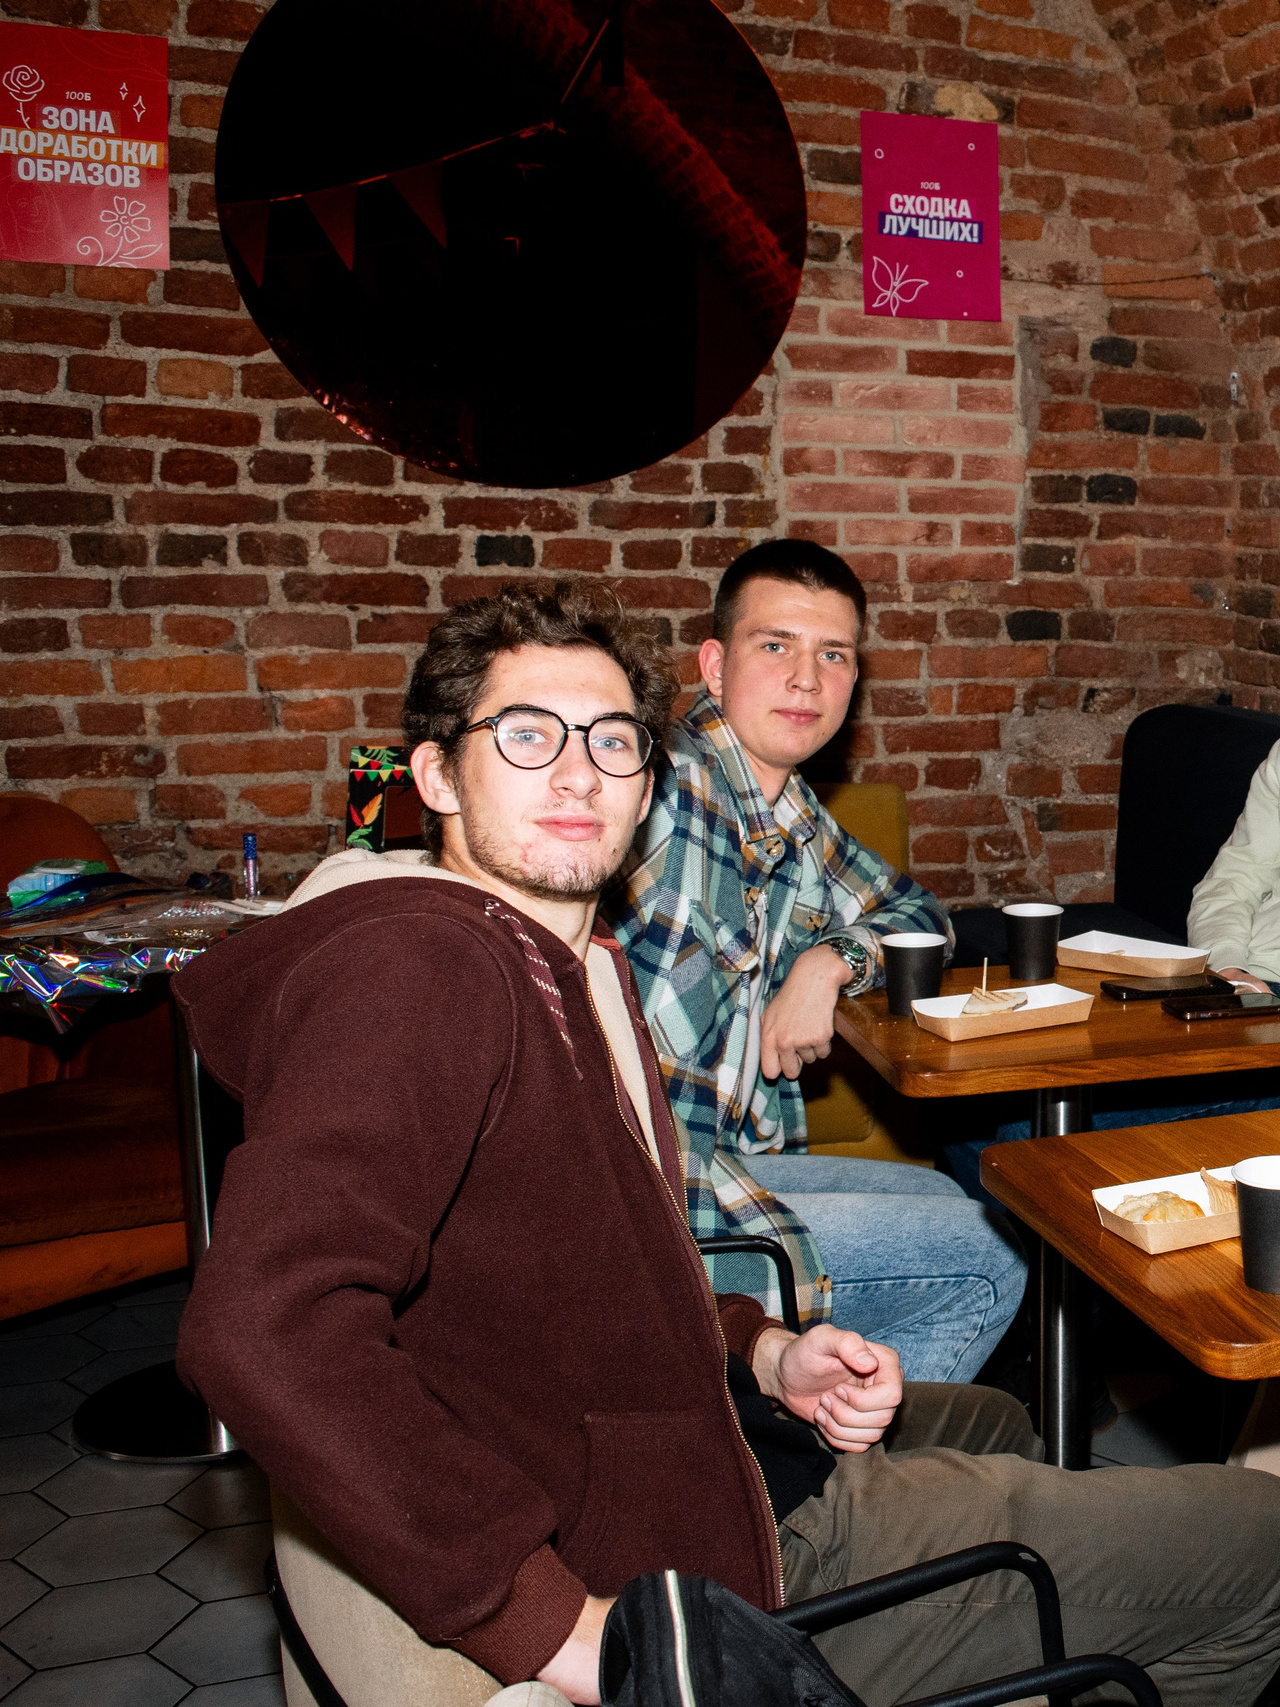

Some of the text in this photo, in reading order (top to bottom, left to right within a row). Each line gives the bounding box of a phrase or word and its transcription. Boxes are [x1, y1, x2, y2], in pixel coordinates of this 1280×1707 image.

[41, 106, 116, 134] ЗОНА
[0, 127, 158, 166] ДОРАБОТКИ
[17, 157, 141, 188] ОБРАЗОВ
[889, 193, 972, 219] СХОДКА
[882, 214, 979, 243] ЛУЧШИХ!
